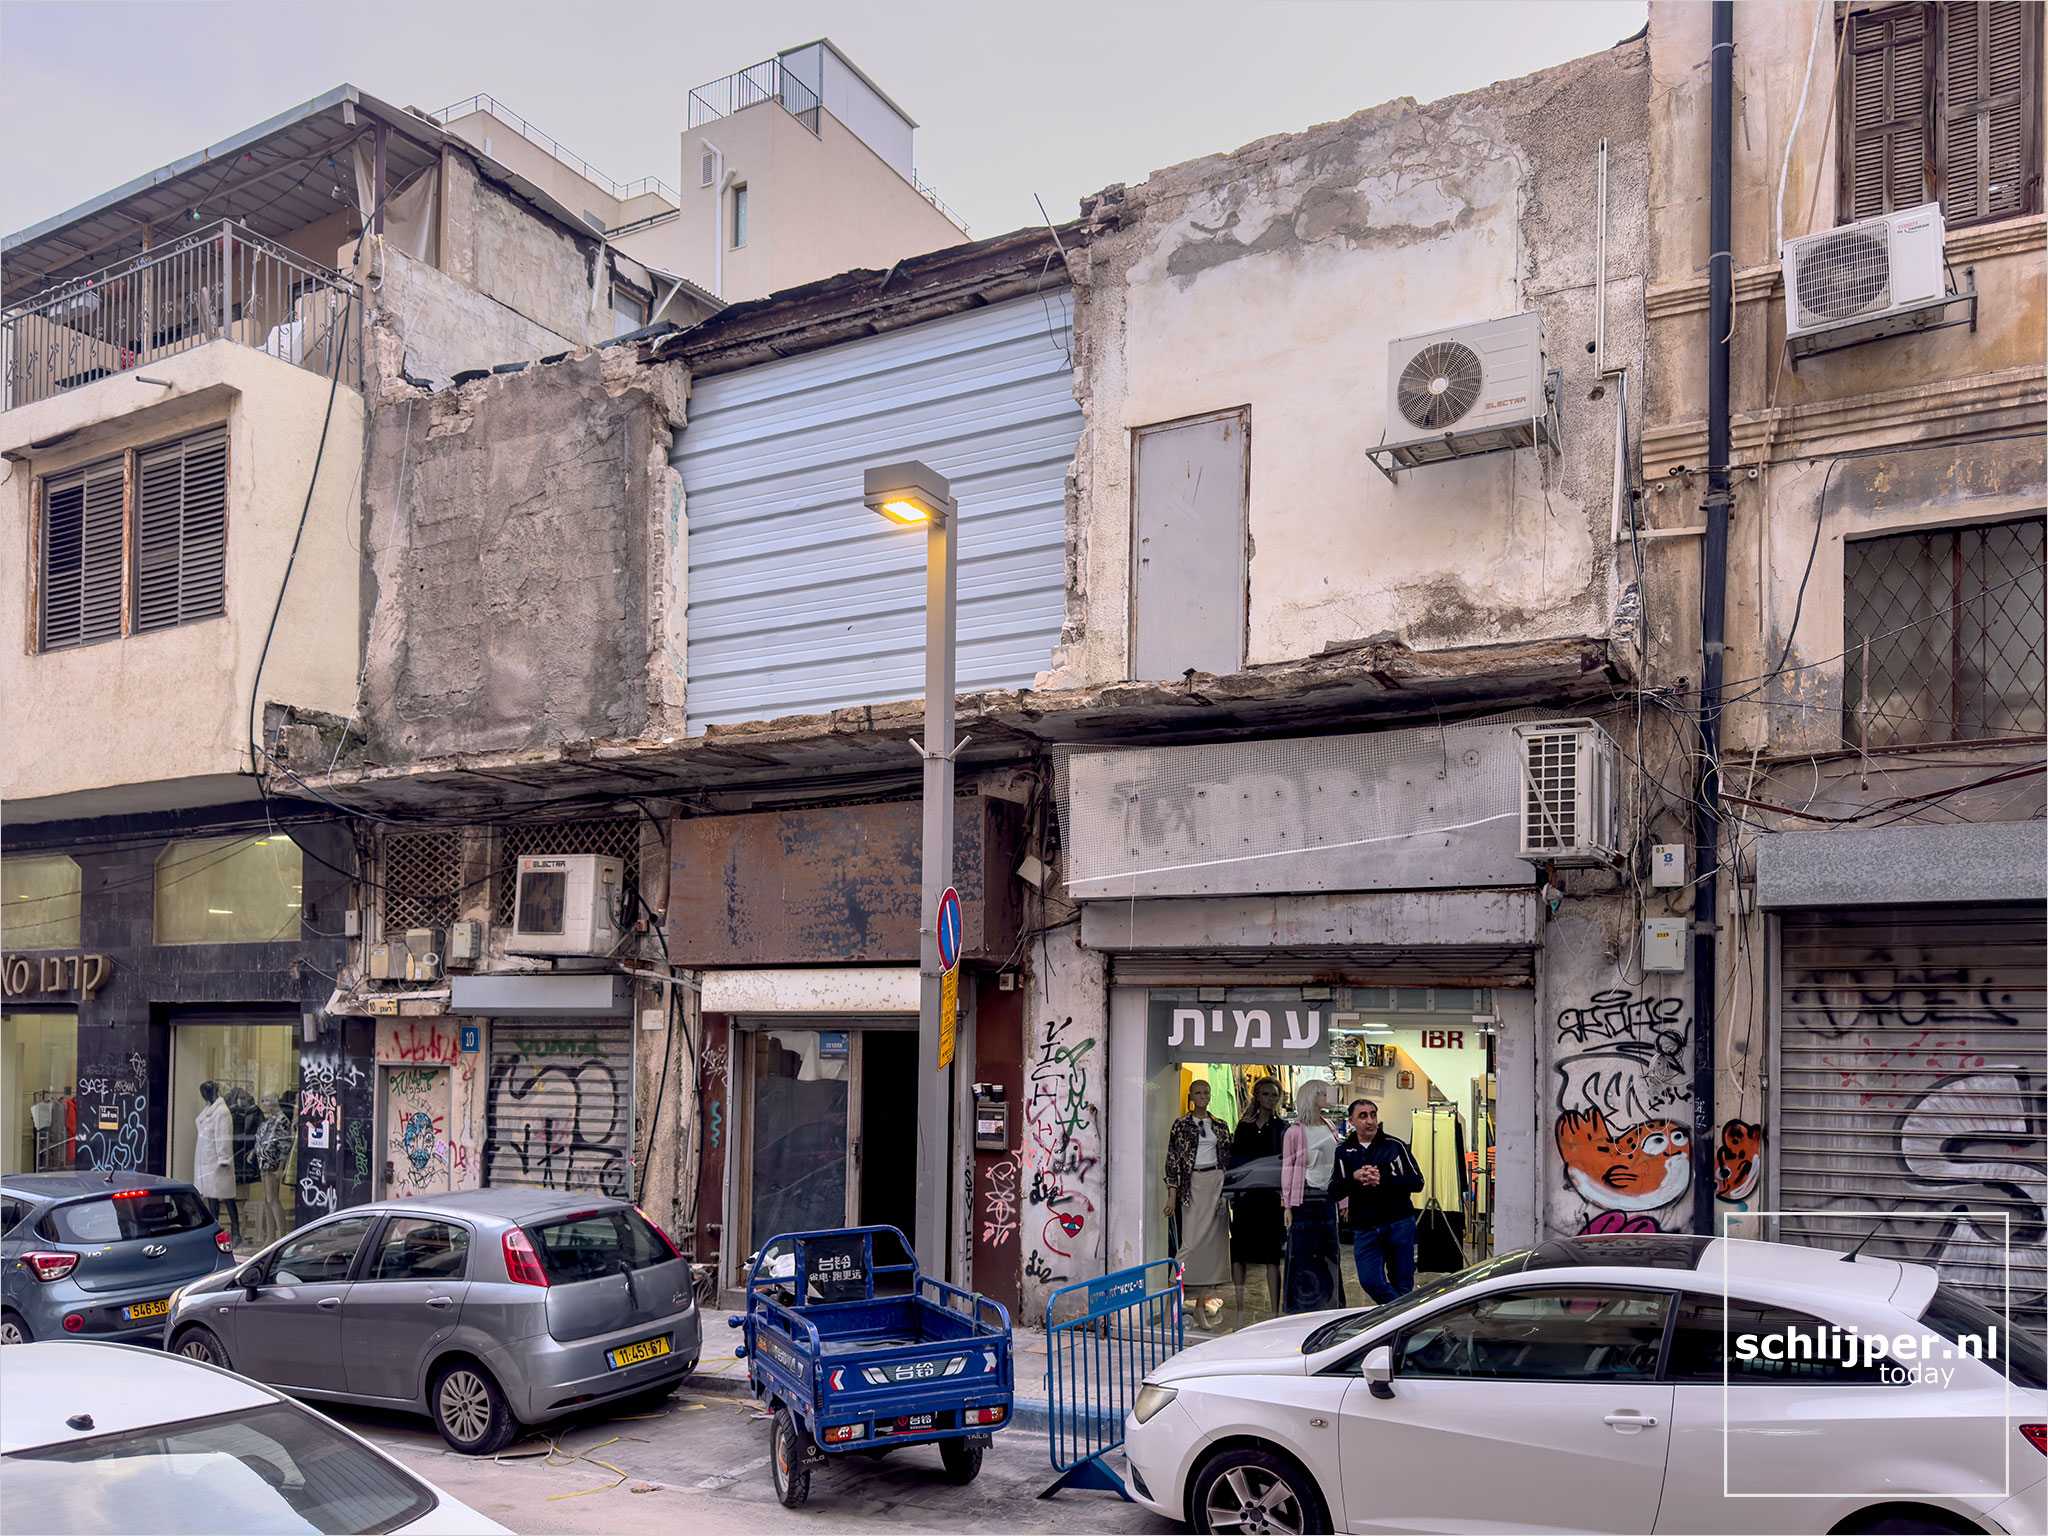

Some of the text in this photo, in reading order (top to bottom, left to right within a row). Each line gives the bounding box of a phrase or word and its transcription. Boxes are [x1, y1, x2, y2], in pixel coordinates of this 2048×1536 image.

[1485, 396, 1526, 410] ELECTRA
[532, 860, 566, 868] ELECTRA
[1167, 1008, 1321, 1050] עמית
[465, 1031, 475, 1048] 10
[1421, 1030, 1464, 1050] IBR
[818, 1255, 851, 1271] 台铃
[895, 1362, 934, 1380] 台铃
[801, 1455, 825, 1465] TAILG
